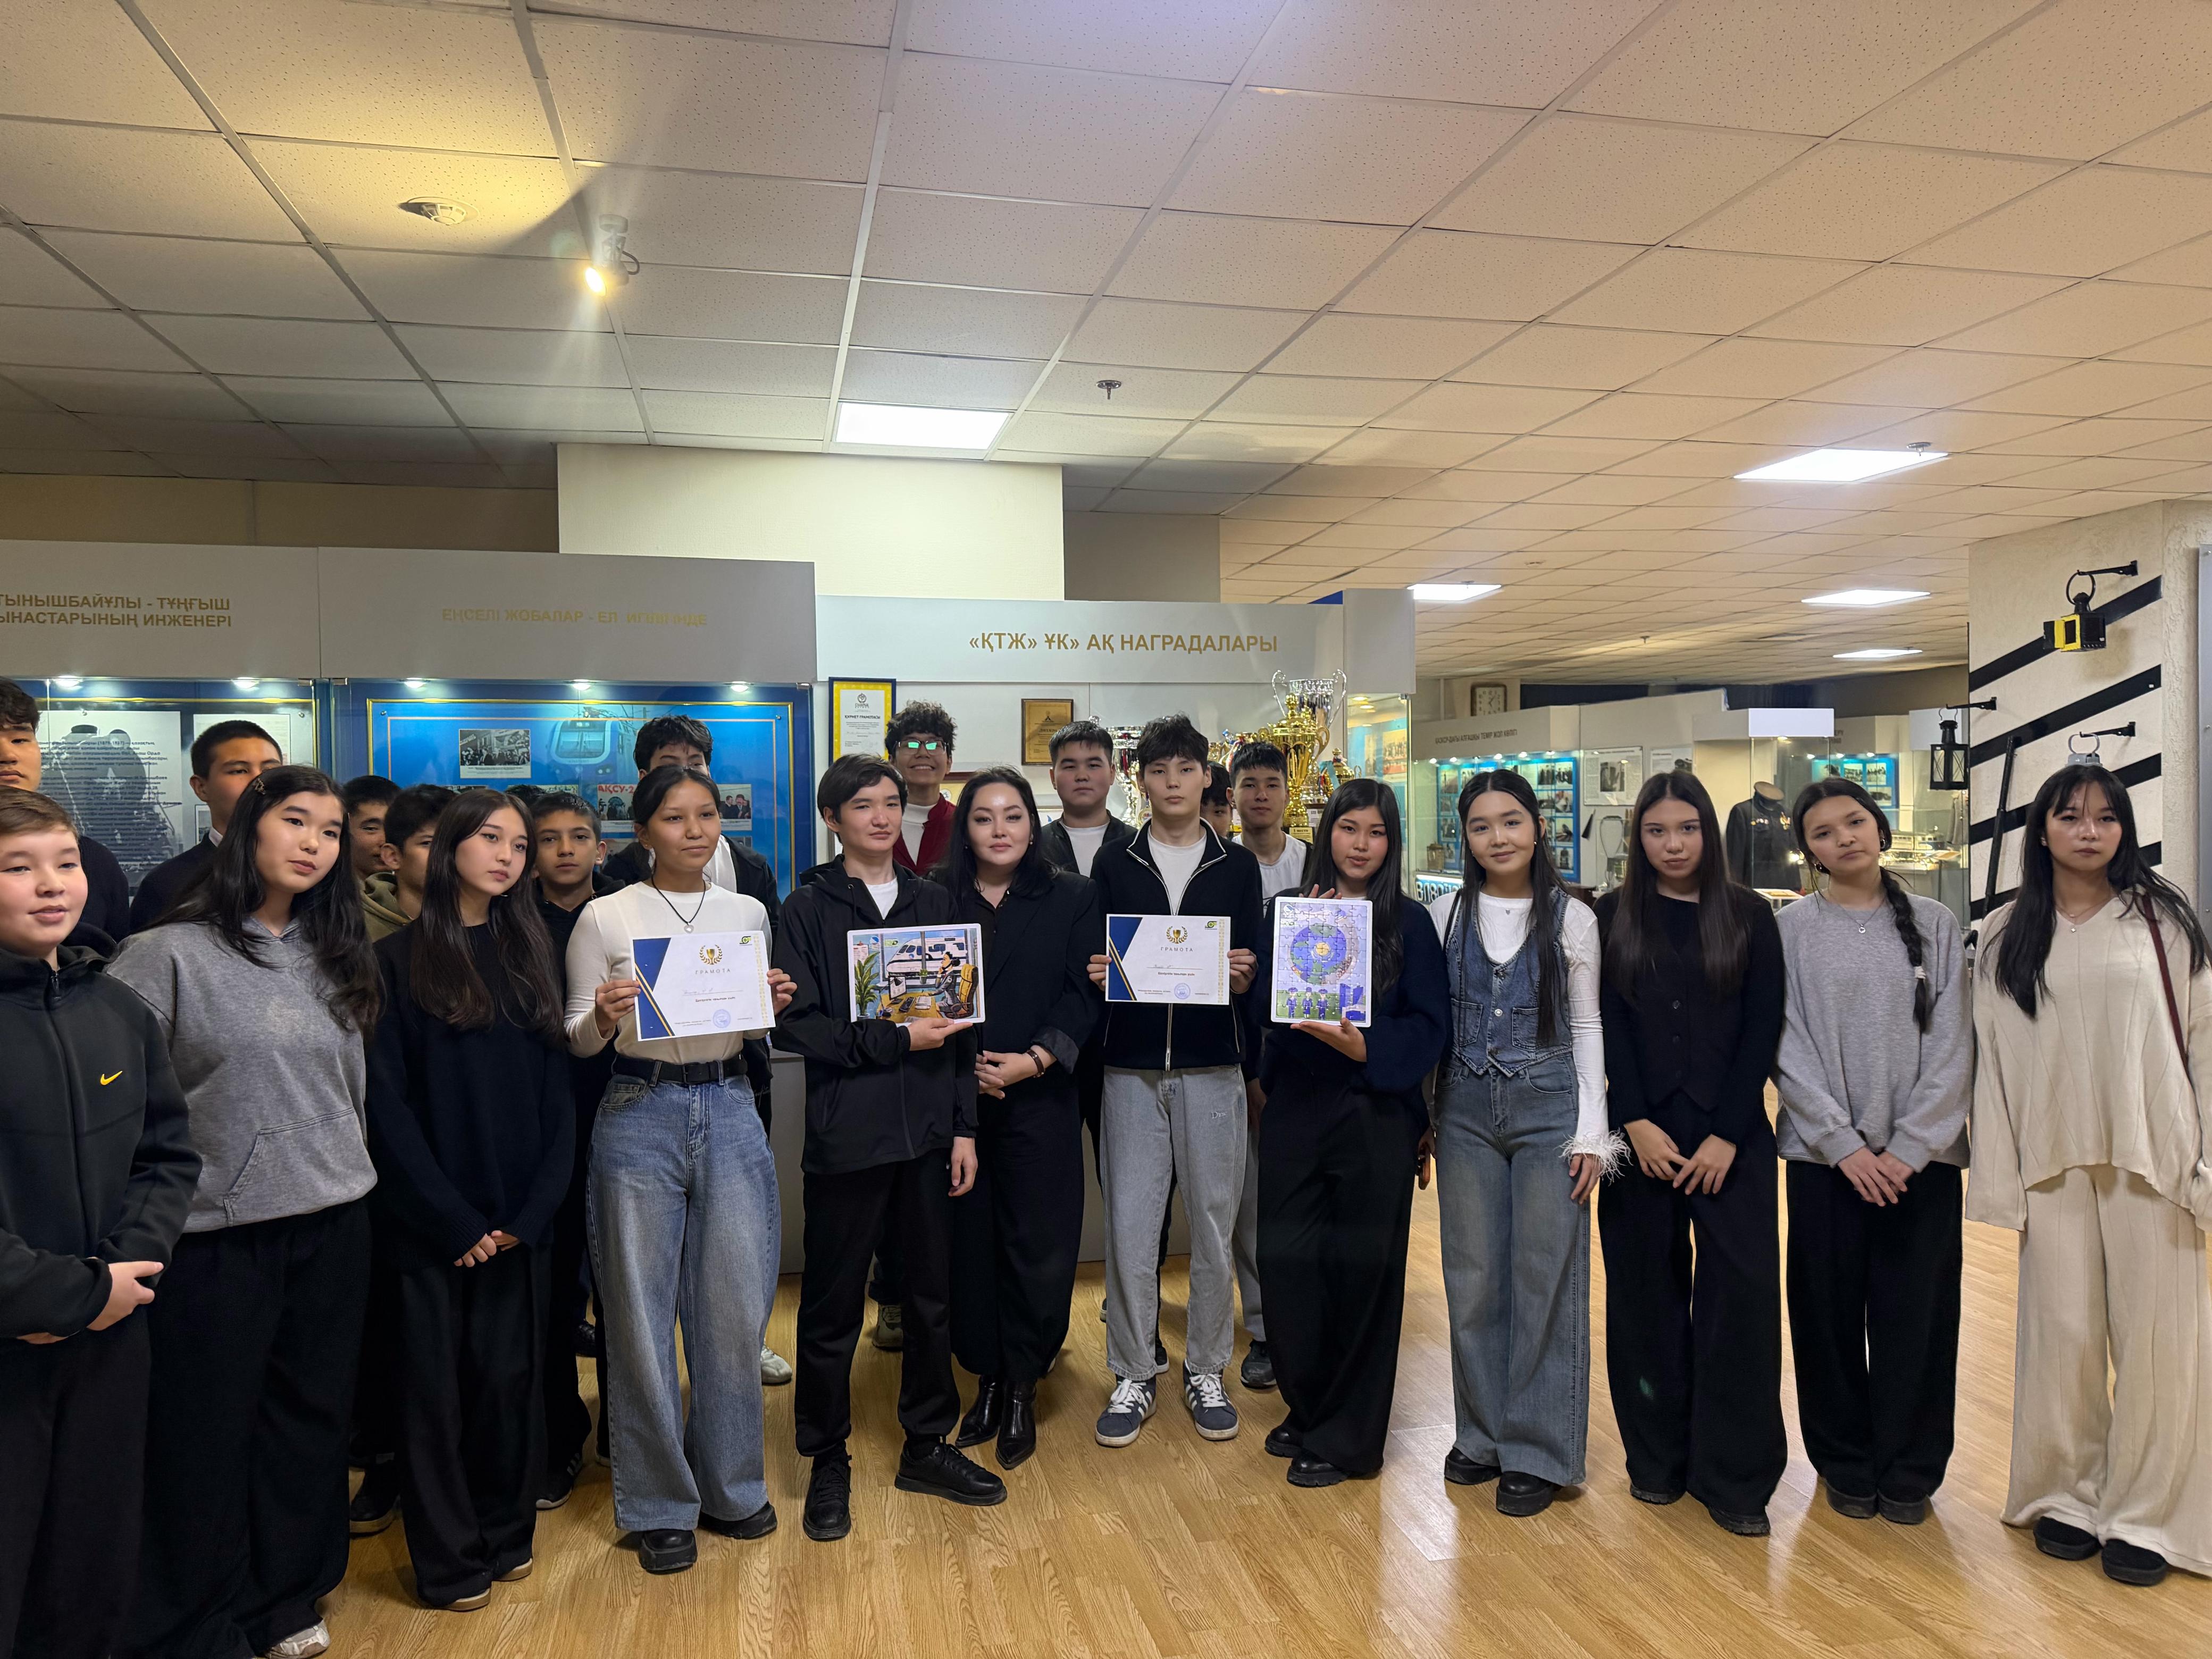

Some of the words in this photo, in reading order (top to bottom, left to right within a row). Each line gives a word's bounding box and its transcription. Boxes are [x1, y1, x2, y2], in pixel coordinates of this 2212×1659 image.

[157, 598, 229, 611] ТҰҢҒЫШ
[144, 614, 231, 627] ИНЖЕНЕРІ
[505, 609, 584, 622] ЖОБАЛАР
[969, 633, 1037, 652] «ҚТЖ»
[1044, 633, 1080, 650] ҰК»
[1086, 634, 1115, 654] АҚ
[1121, 634, 1277, 655] НАГРАДАЛАРЫ
